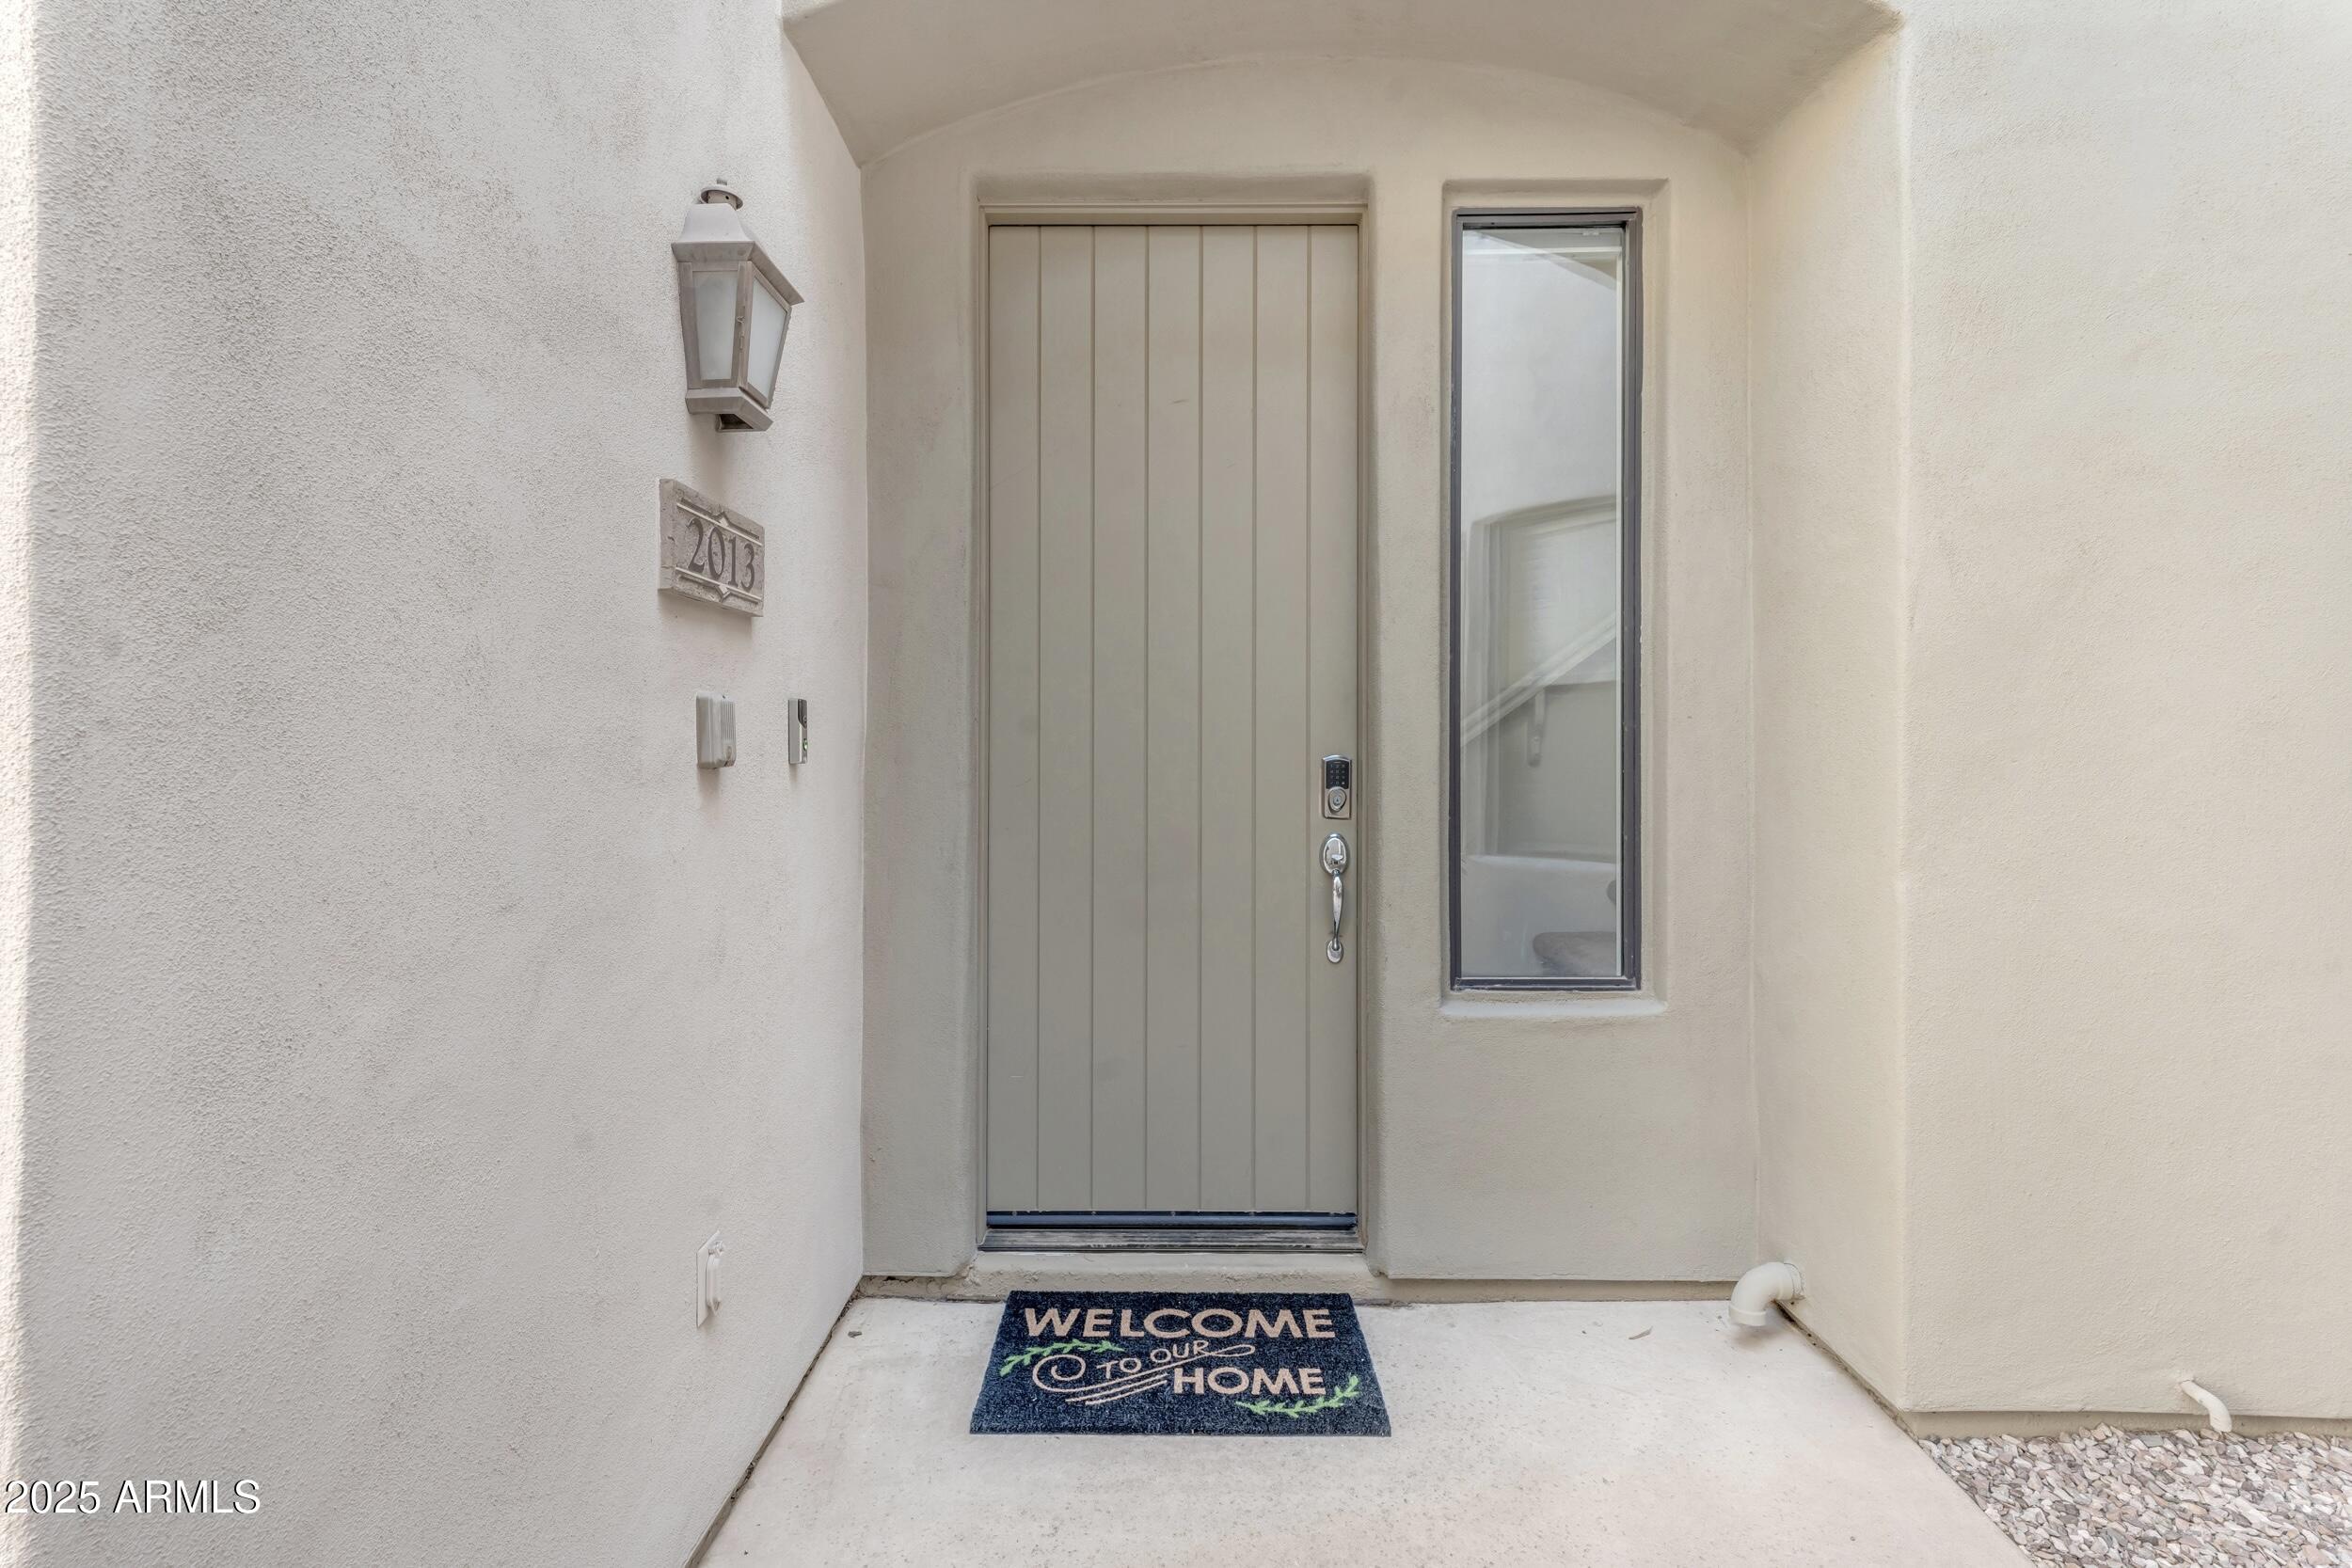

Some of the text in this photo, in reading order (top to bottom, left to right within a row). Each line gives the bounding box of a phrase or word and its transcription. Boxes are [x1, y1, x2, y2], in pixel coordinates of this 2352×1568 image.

[686, 517, 755, 592] 2013
[1024, 1308, 1335, 1338] WELCOME
[1097, 1339, 1208, 1380] TO OUR
[1174, 1367, 1326, 1395] HOME
